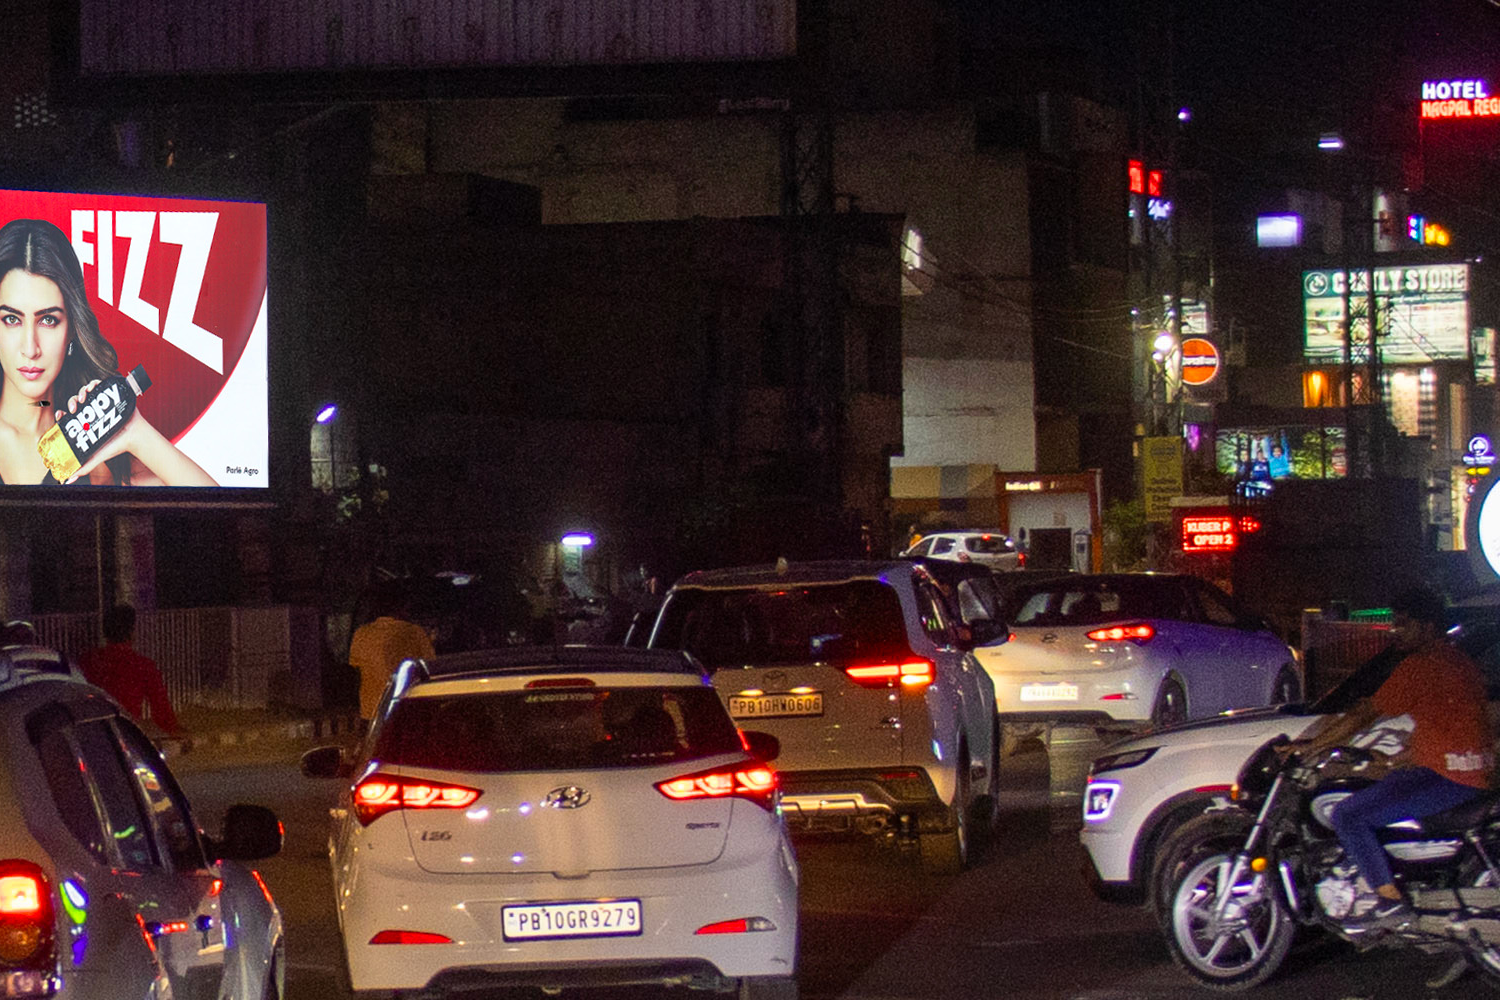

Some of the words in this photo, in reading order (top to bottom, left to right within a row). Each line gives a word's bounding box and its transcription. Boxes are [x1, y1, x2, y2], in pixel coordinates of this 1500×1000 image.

[1422, 81, 1487, 100] HOTEL
[1422, 101, 1472, 118] NAGPAL
[1474, 97, 1500, 116] REG
[1405, 268, 1466, 291] STORE
[70, 209, 224, 376] FIZZ
[65, 383, 121, 439] appy
[75, 407, 123, 453] fizz
[1194, 534, 1223, 546] OPEN
[519, 907, 636, 932] PB10GR9279
